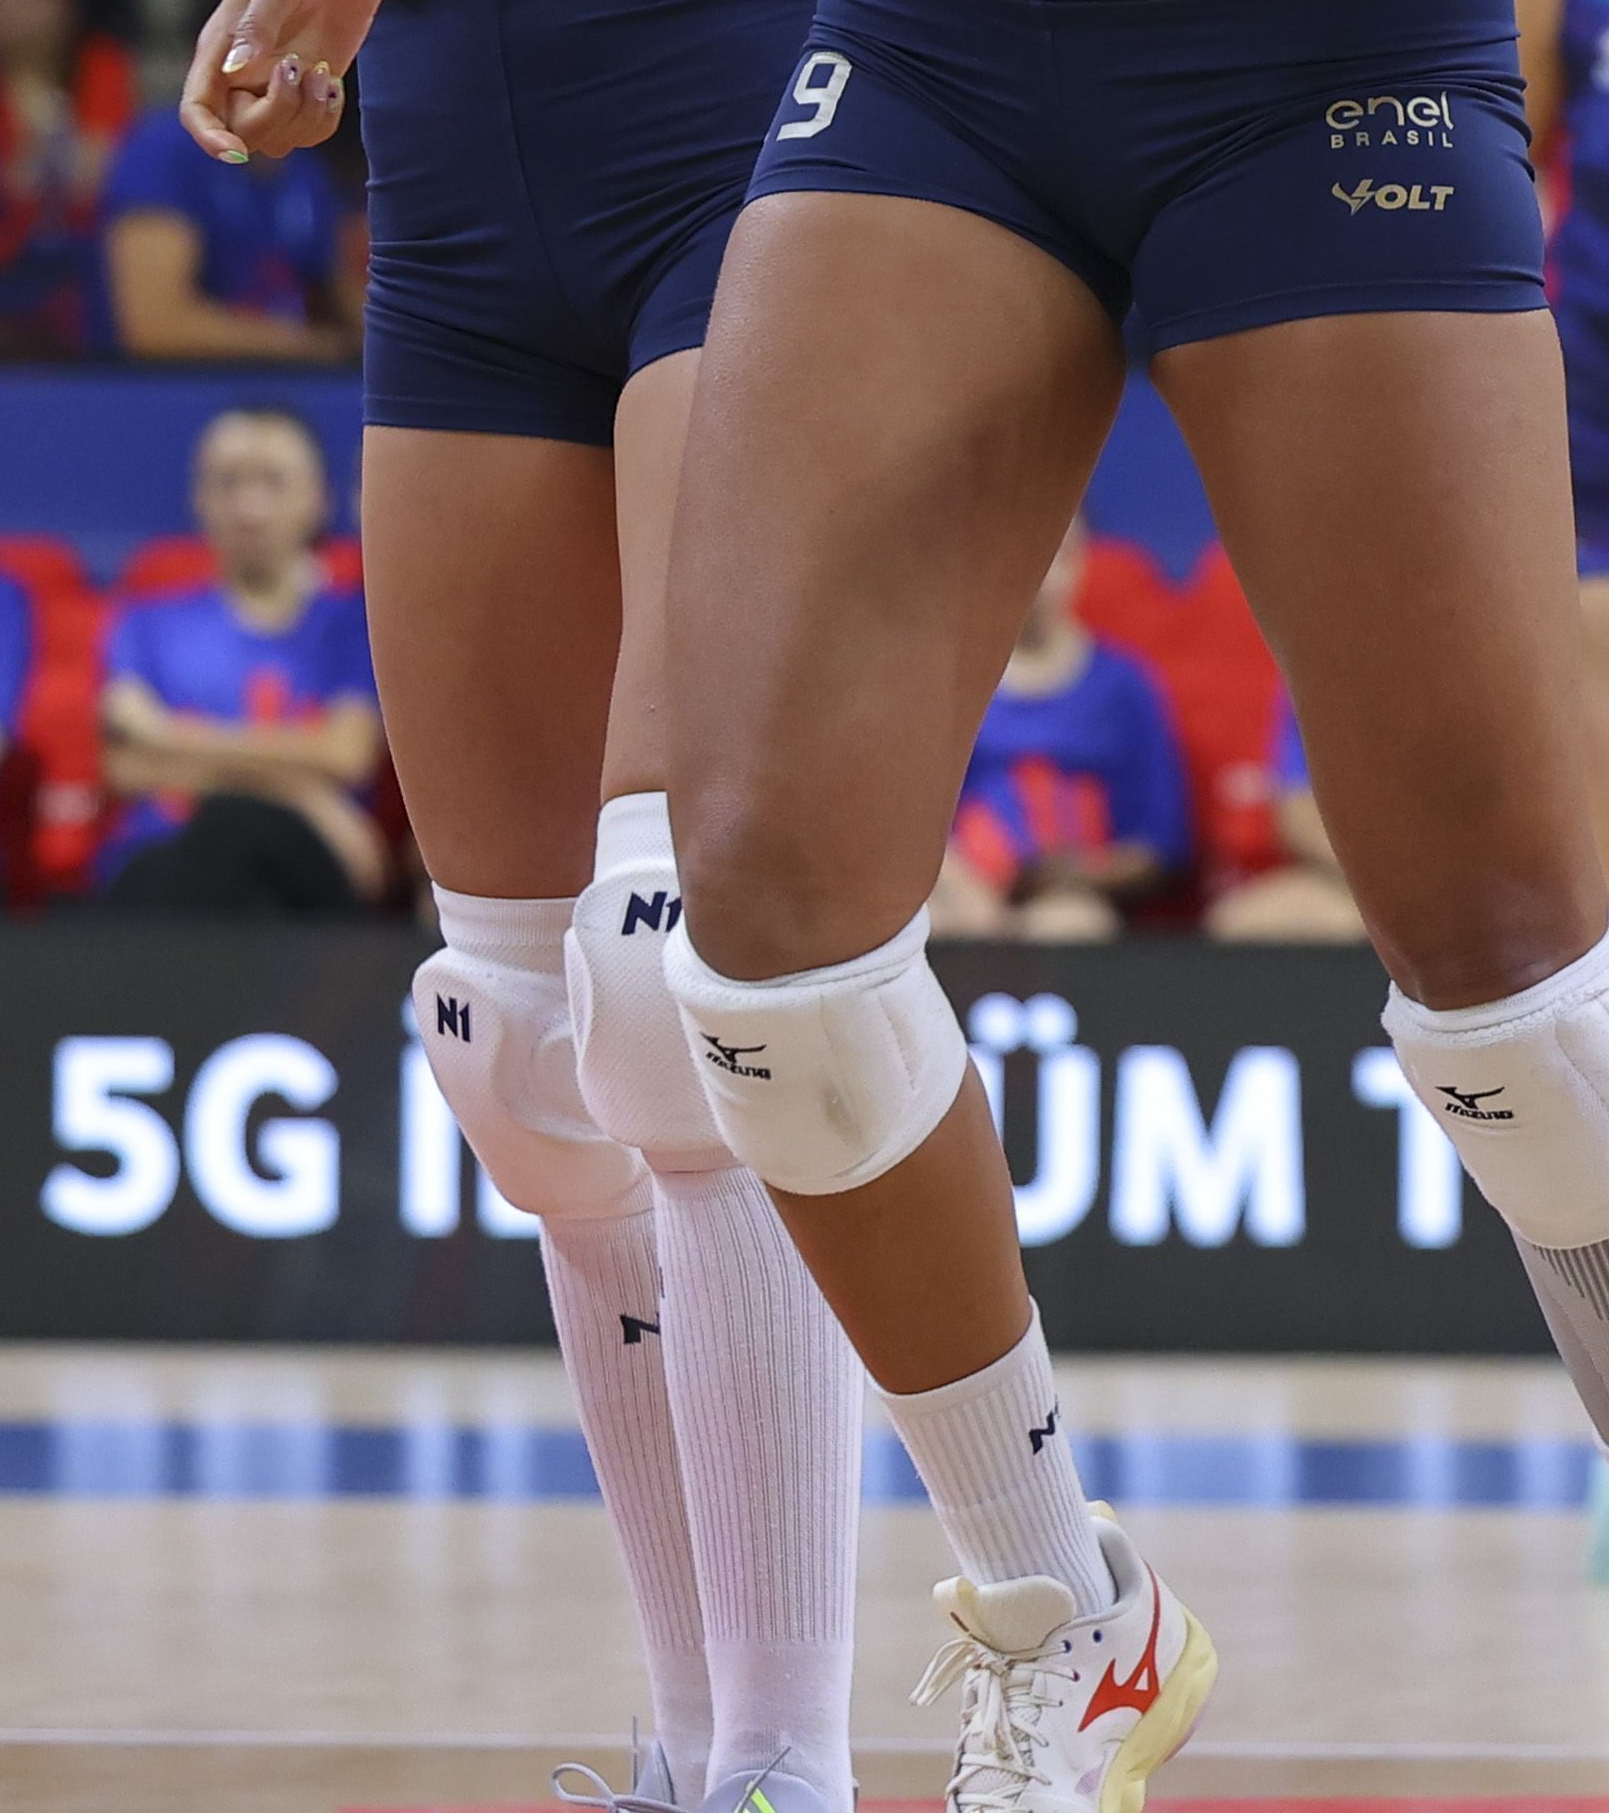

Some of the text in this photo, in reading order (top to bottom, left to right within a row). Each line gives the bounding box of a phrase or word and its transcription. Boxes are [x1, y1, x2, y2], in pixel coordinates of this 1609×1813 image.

[775, 50, 853, 141] 9
[1325, 91, 1454, 131] enel
[1330, 130, 1454, 149] BRASIL
[1332, 179, 1455, 216] VOLT
[436, 991, 471, 1043] N1
[40, 1032, 340, 1239] 5G
